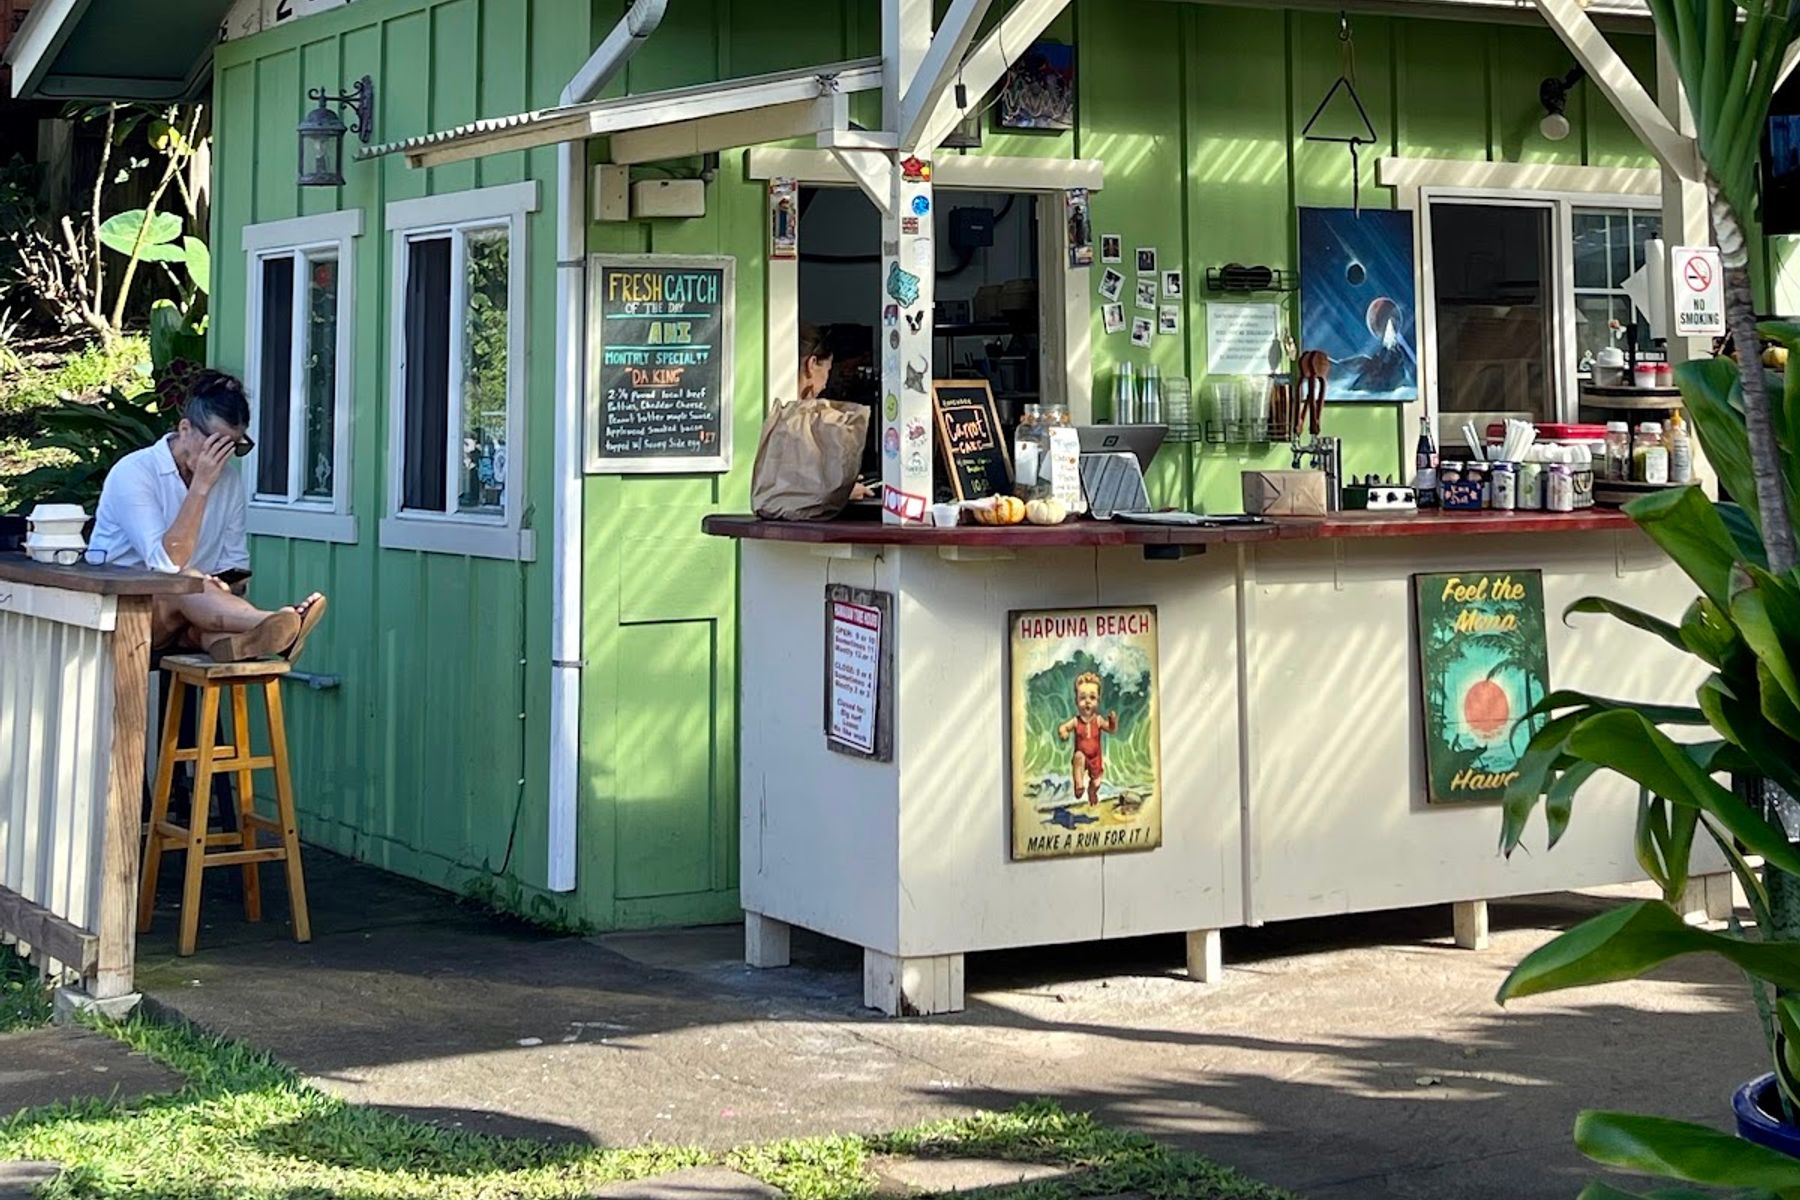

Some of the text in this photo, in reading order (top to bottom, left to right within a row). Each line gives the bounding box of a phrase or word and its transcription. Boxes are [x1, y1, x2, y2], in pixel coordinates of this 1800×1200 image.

[609, 273, 717, 304] FRESH CATCH
[625, 302, 685, 314] OF THE DAY
[1694, 299, 1705, 311] NO
[1680, 313, 1719, 325] SMOKING
[605, 352, 649, 365] MONTHLY
[661, 388, 683, 398] local
[686, 387, 706, 398] beef
[945, 410, 986, 441] Carrot
[1442, 575, 1525, 602] Feel the
[1021, 614, 1149, 639] HAPUNA BEACH
[1451, 768, 1519, 791] Haw
[1027, 834, 1060, 851] MAKE
[1064, 834, 1072, 849] A
[1076, 832, 1100, 848] RUN
[1104, 829, 1126, 845] FOR
